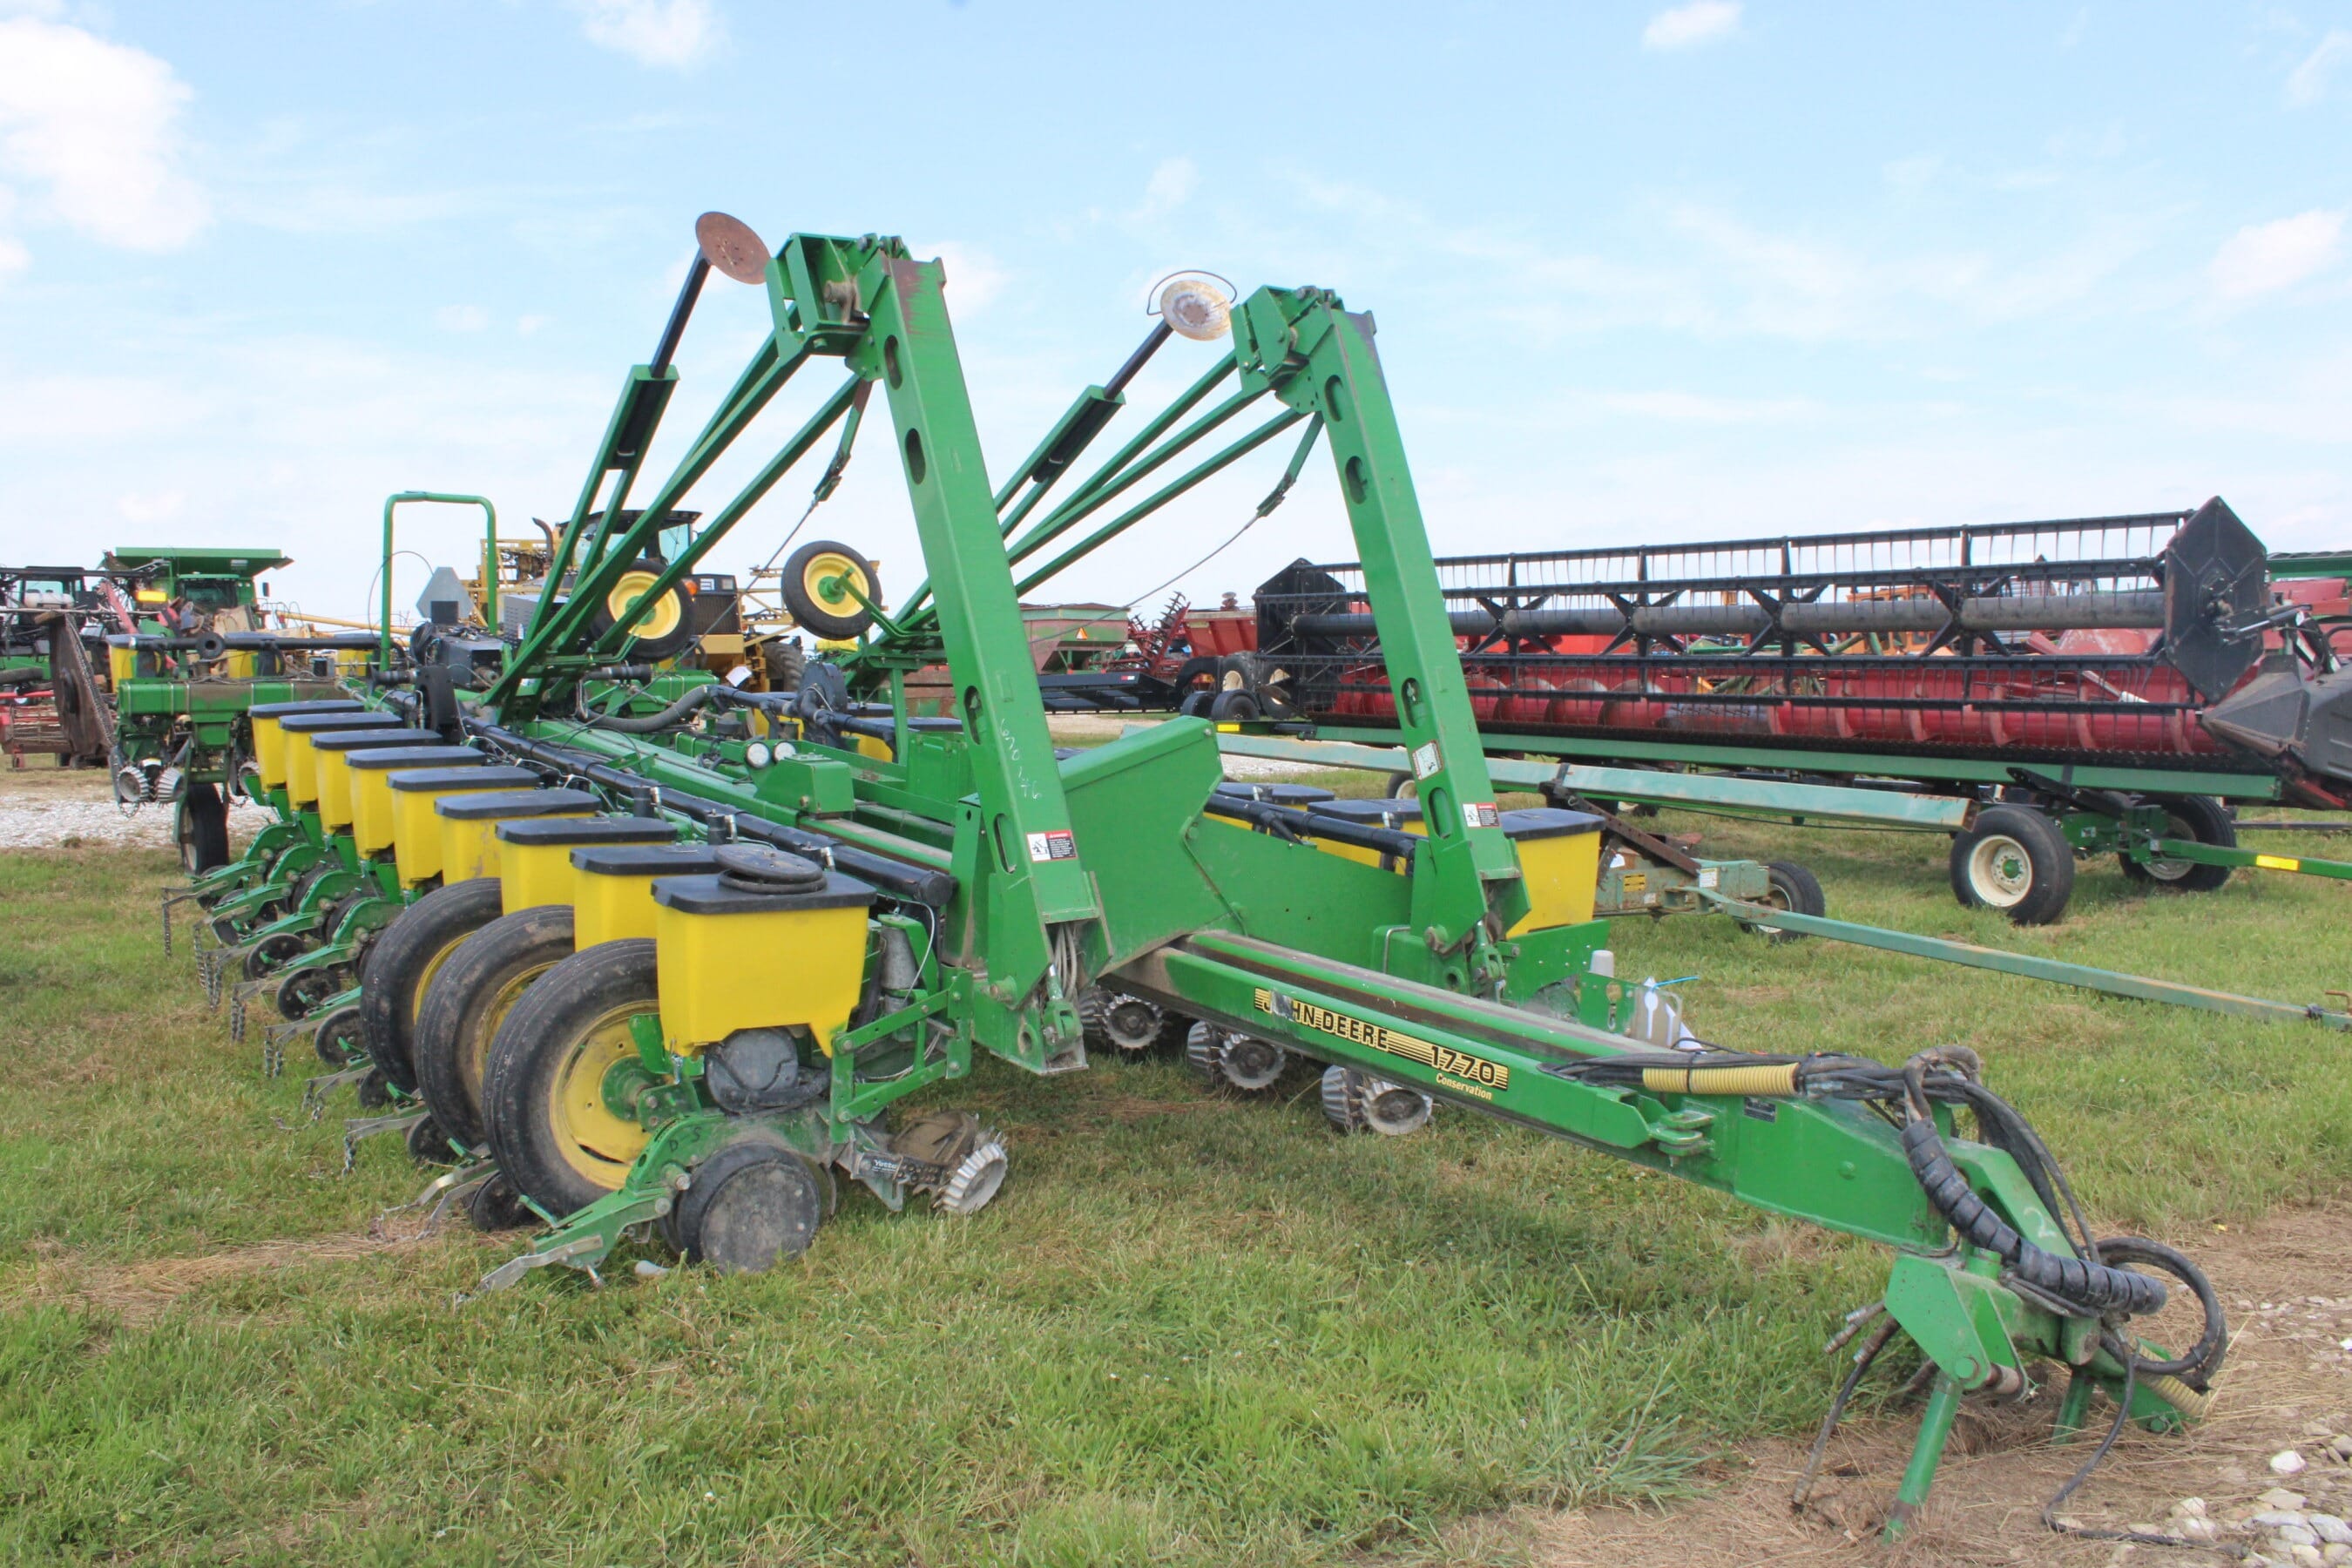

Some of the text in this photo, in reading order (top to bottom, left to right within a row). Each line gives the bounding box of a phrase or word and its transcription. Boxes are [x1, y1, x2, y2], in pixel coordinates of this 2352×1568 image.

[1321, 1010, 1389, 1050] DEERE
[1430, 1045, 1496, 1085] 1770
[1436, 1072, 1492, 1100] Conservation
